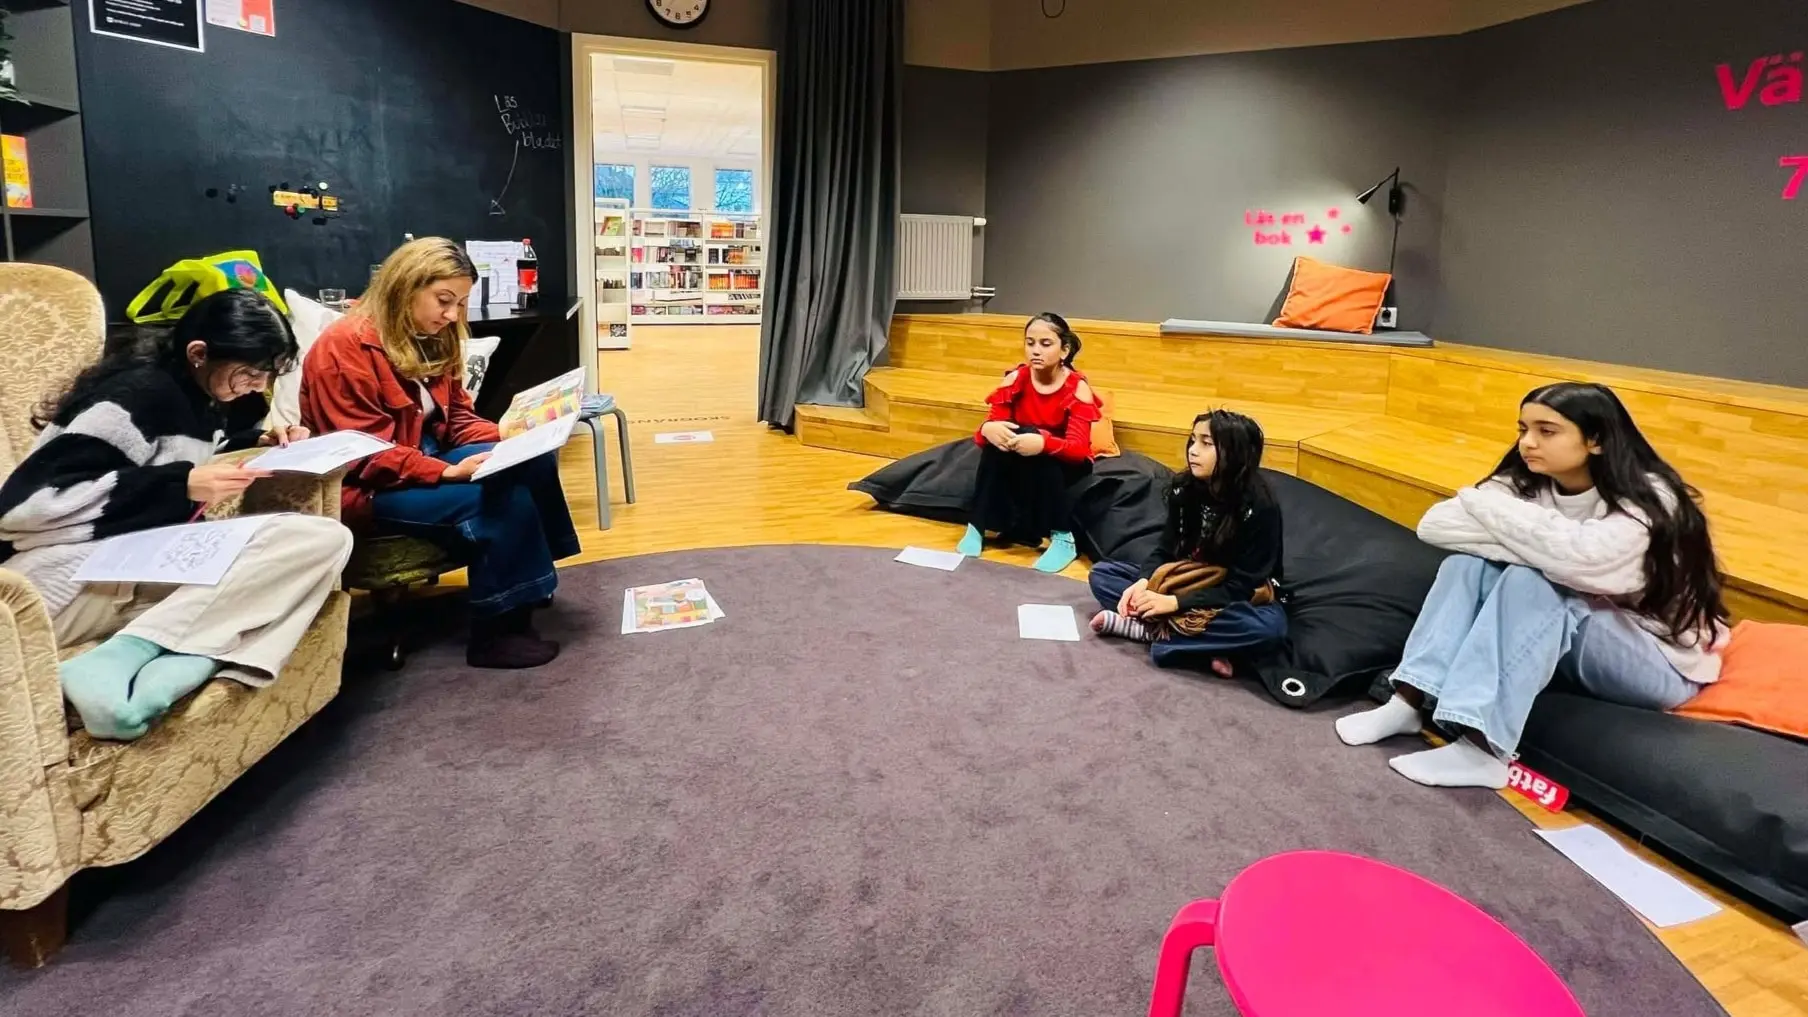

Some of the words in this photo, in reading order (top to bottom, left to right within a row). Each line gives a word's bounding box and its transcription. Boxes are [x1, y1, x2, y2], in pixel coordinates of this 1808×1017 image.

[665, 8, 671, 16] 7
[674, 12, 681, 20] 6
[685, 10, 692, 18] 5
[494, 94, 518, 113] Läs
[1281, 212, 1305, 225] en
[1254, 229, 1291, 245] bok
